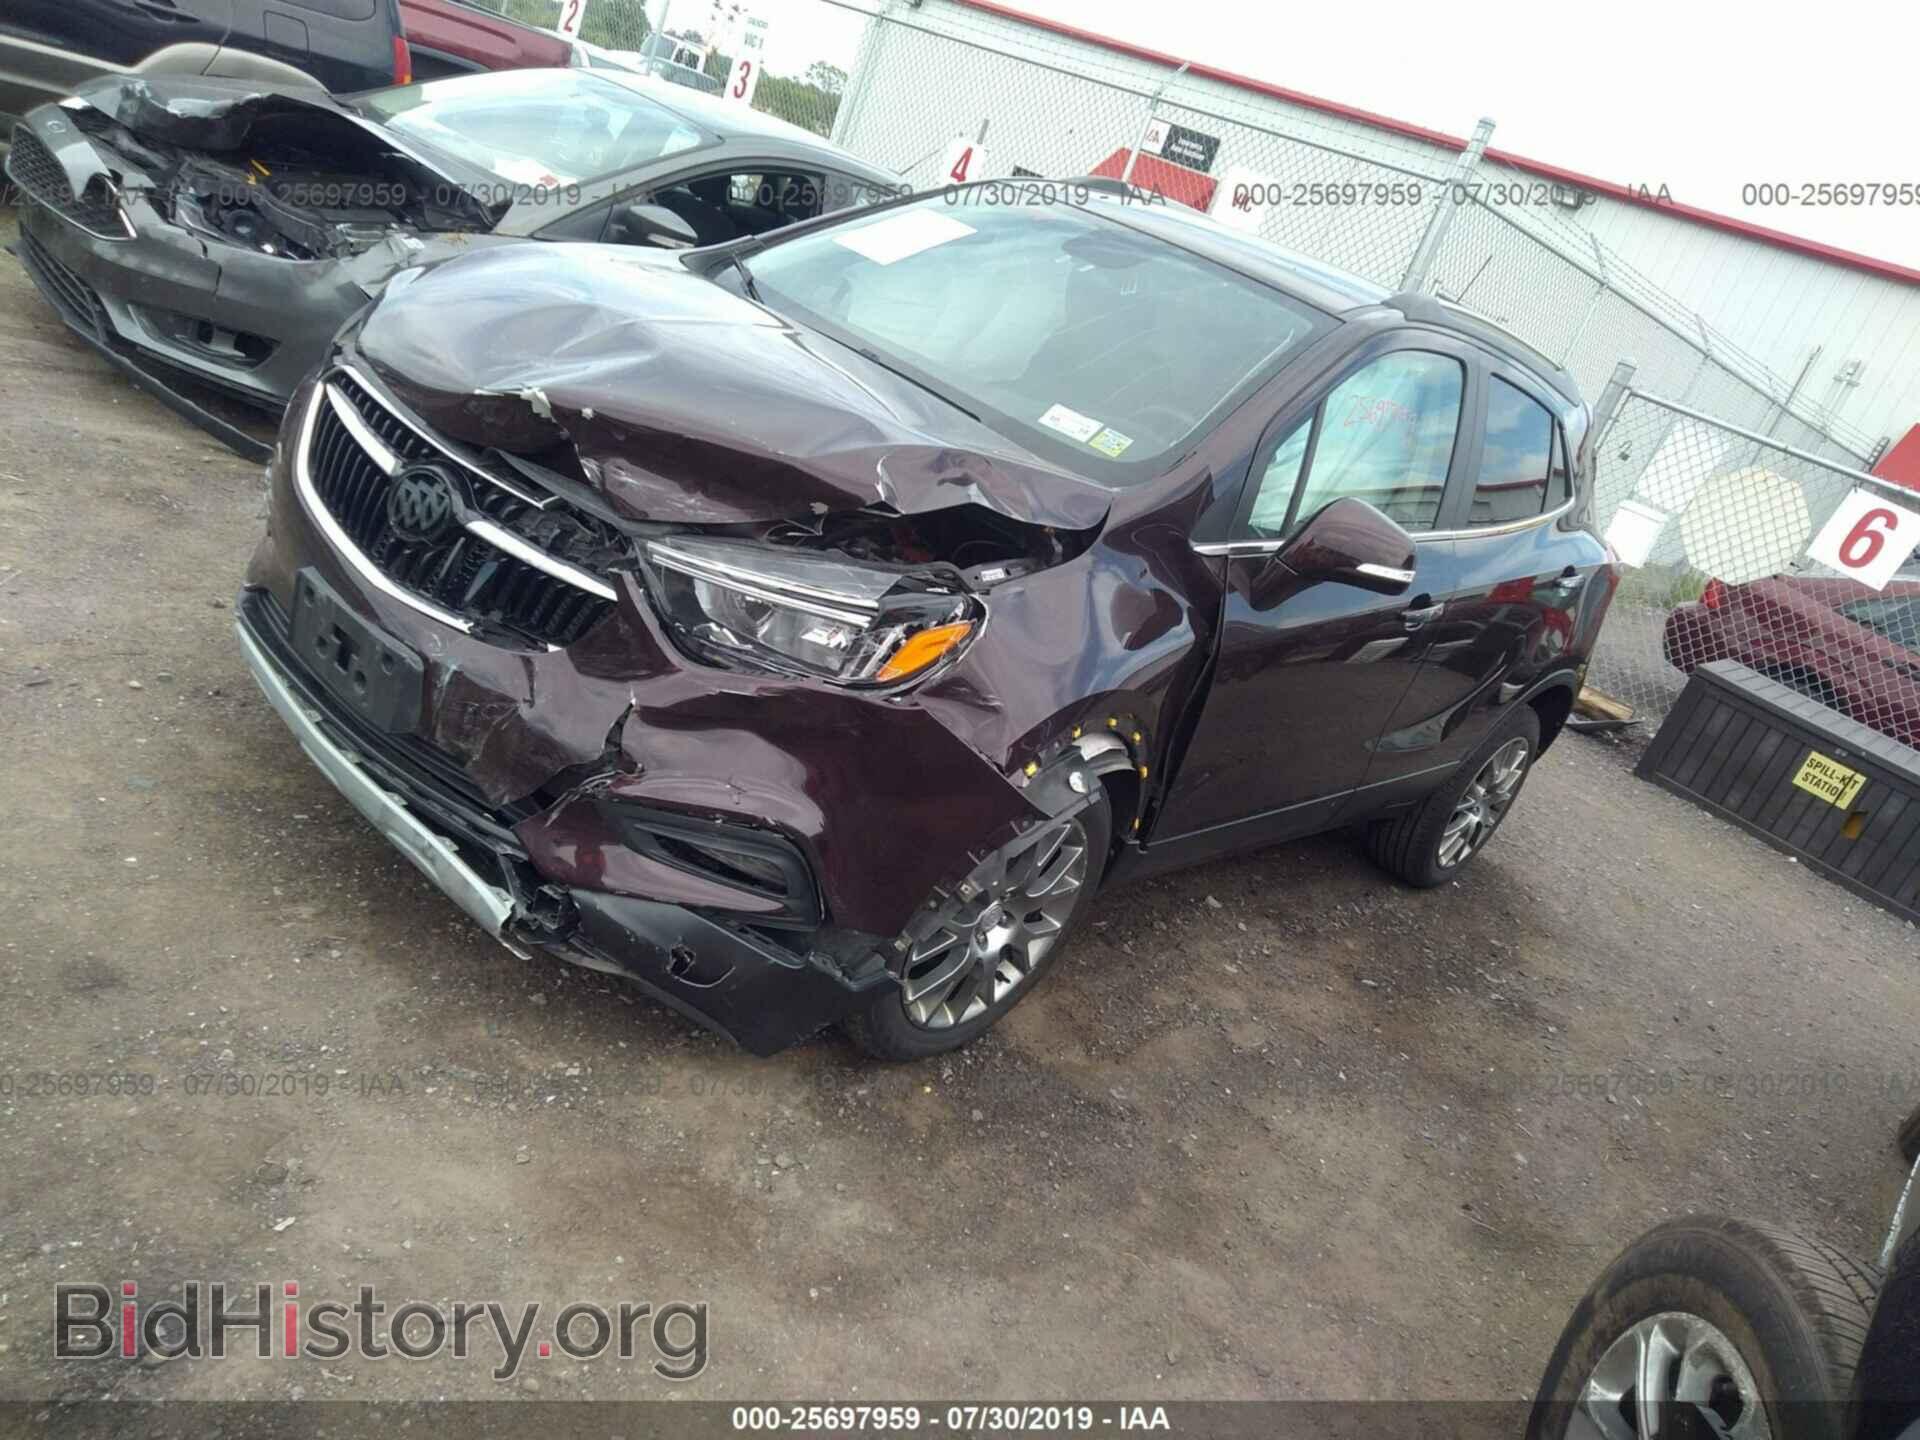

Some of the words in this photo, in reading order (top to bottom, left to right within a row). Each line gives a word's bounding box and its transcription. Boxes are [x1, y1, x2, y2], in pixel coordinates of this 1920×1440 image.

[563, 0, 579, 32] 2
[733, 60, 752, 99] 3
[950, 146, 974, 182] 4
[1838, 507, 1899, 569] 6
[1801, 771, 1846, 799] STATIO
